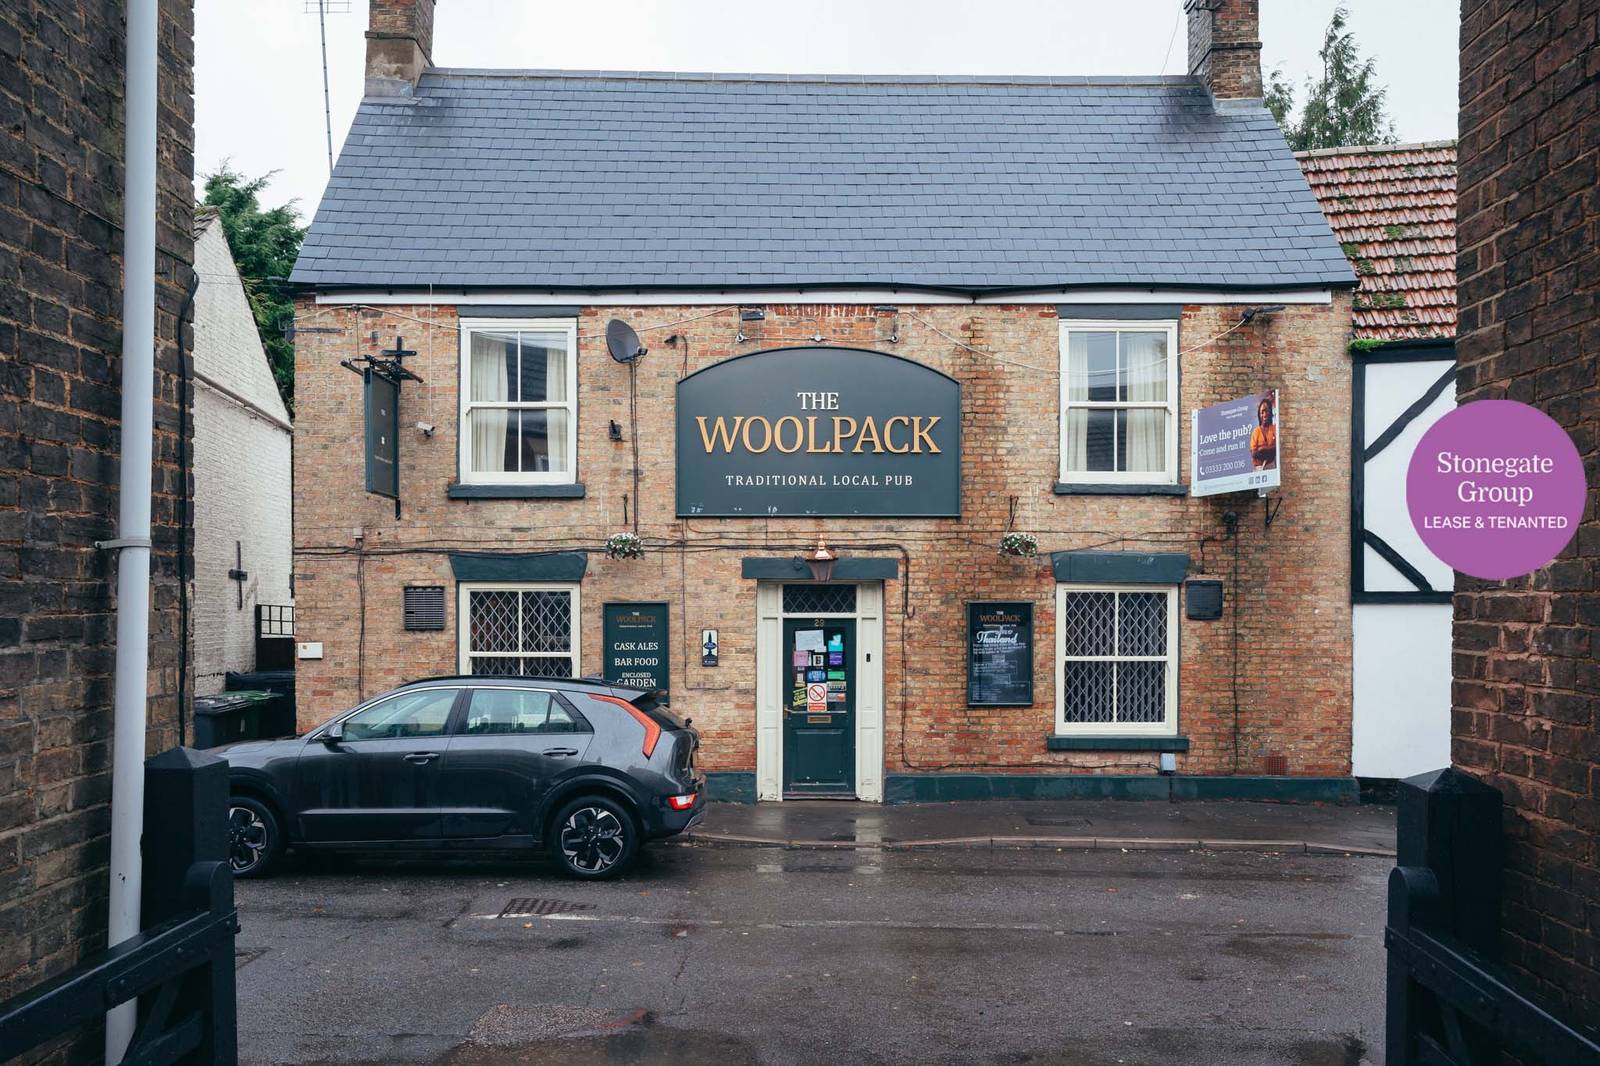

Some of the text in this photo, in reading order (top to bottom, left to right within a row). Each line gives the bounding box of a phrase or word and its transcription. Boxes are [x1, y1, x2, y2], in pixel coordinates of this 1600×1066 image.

[797, 392, 839, 410] THE
[696, 416, 942, 454] WOOLPACK
[1199, 424, 1252, 444] Love the pub?
[1216, 444, 1227, 454] and
[725, 475, 914, 487] TRADITIONAL LOCAL PUB
[976, 630, 1018, 644] Thailand
[614, 642, 659, 651] CASK ALES
[614, 657, 659, 666] BAR FOOD
